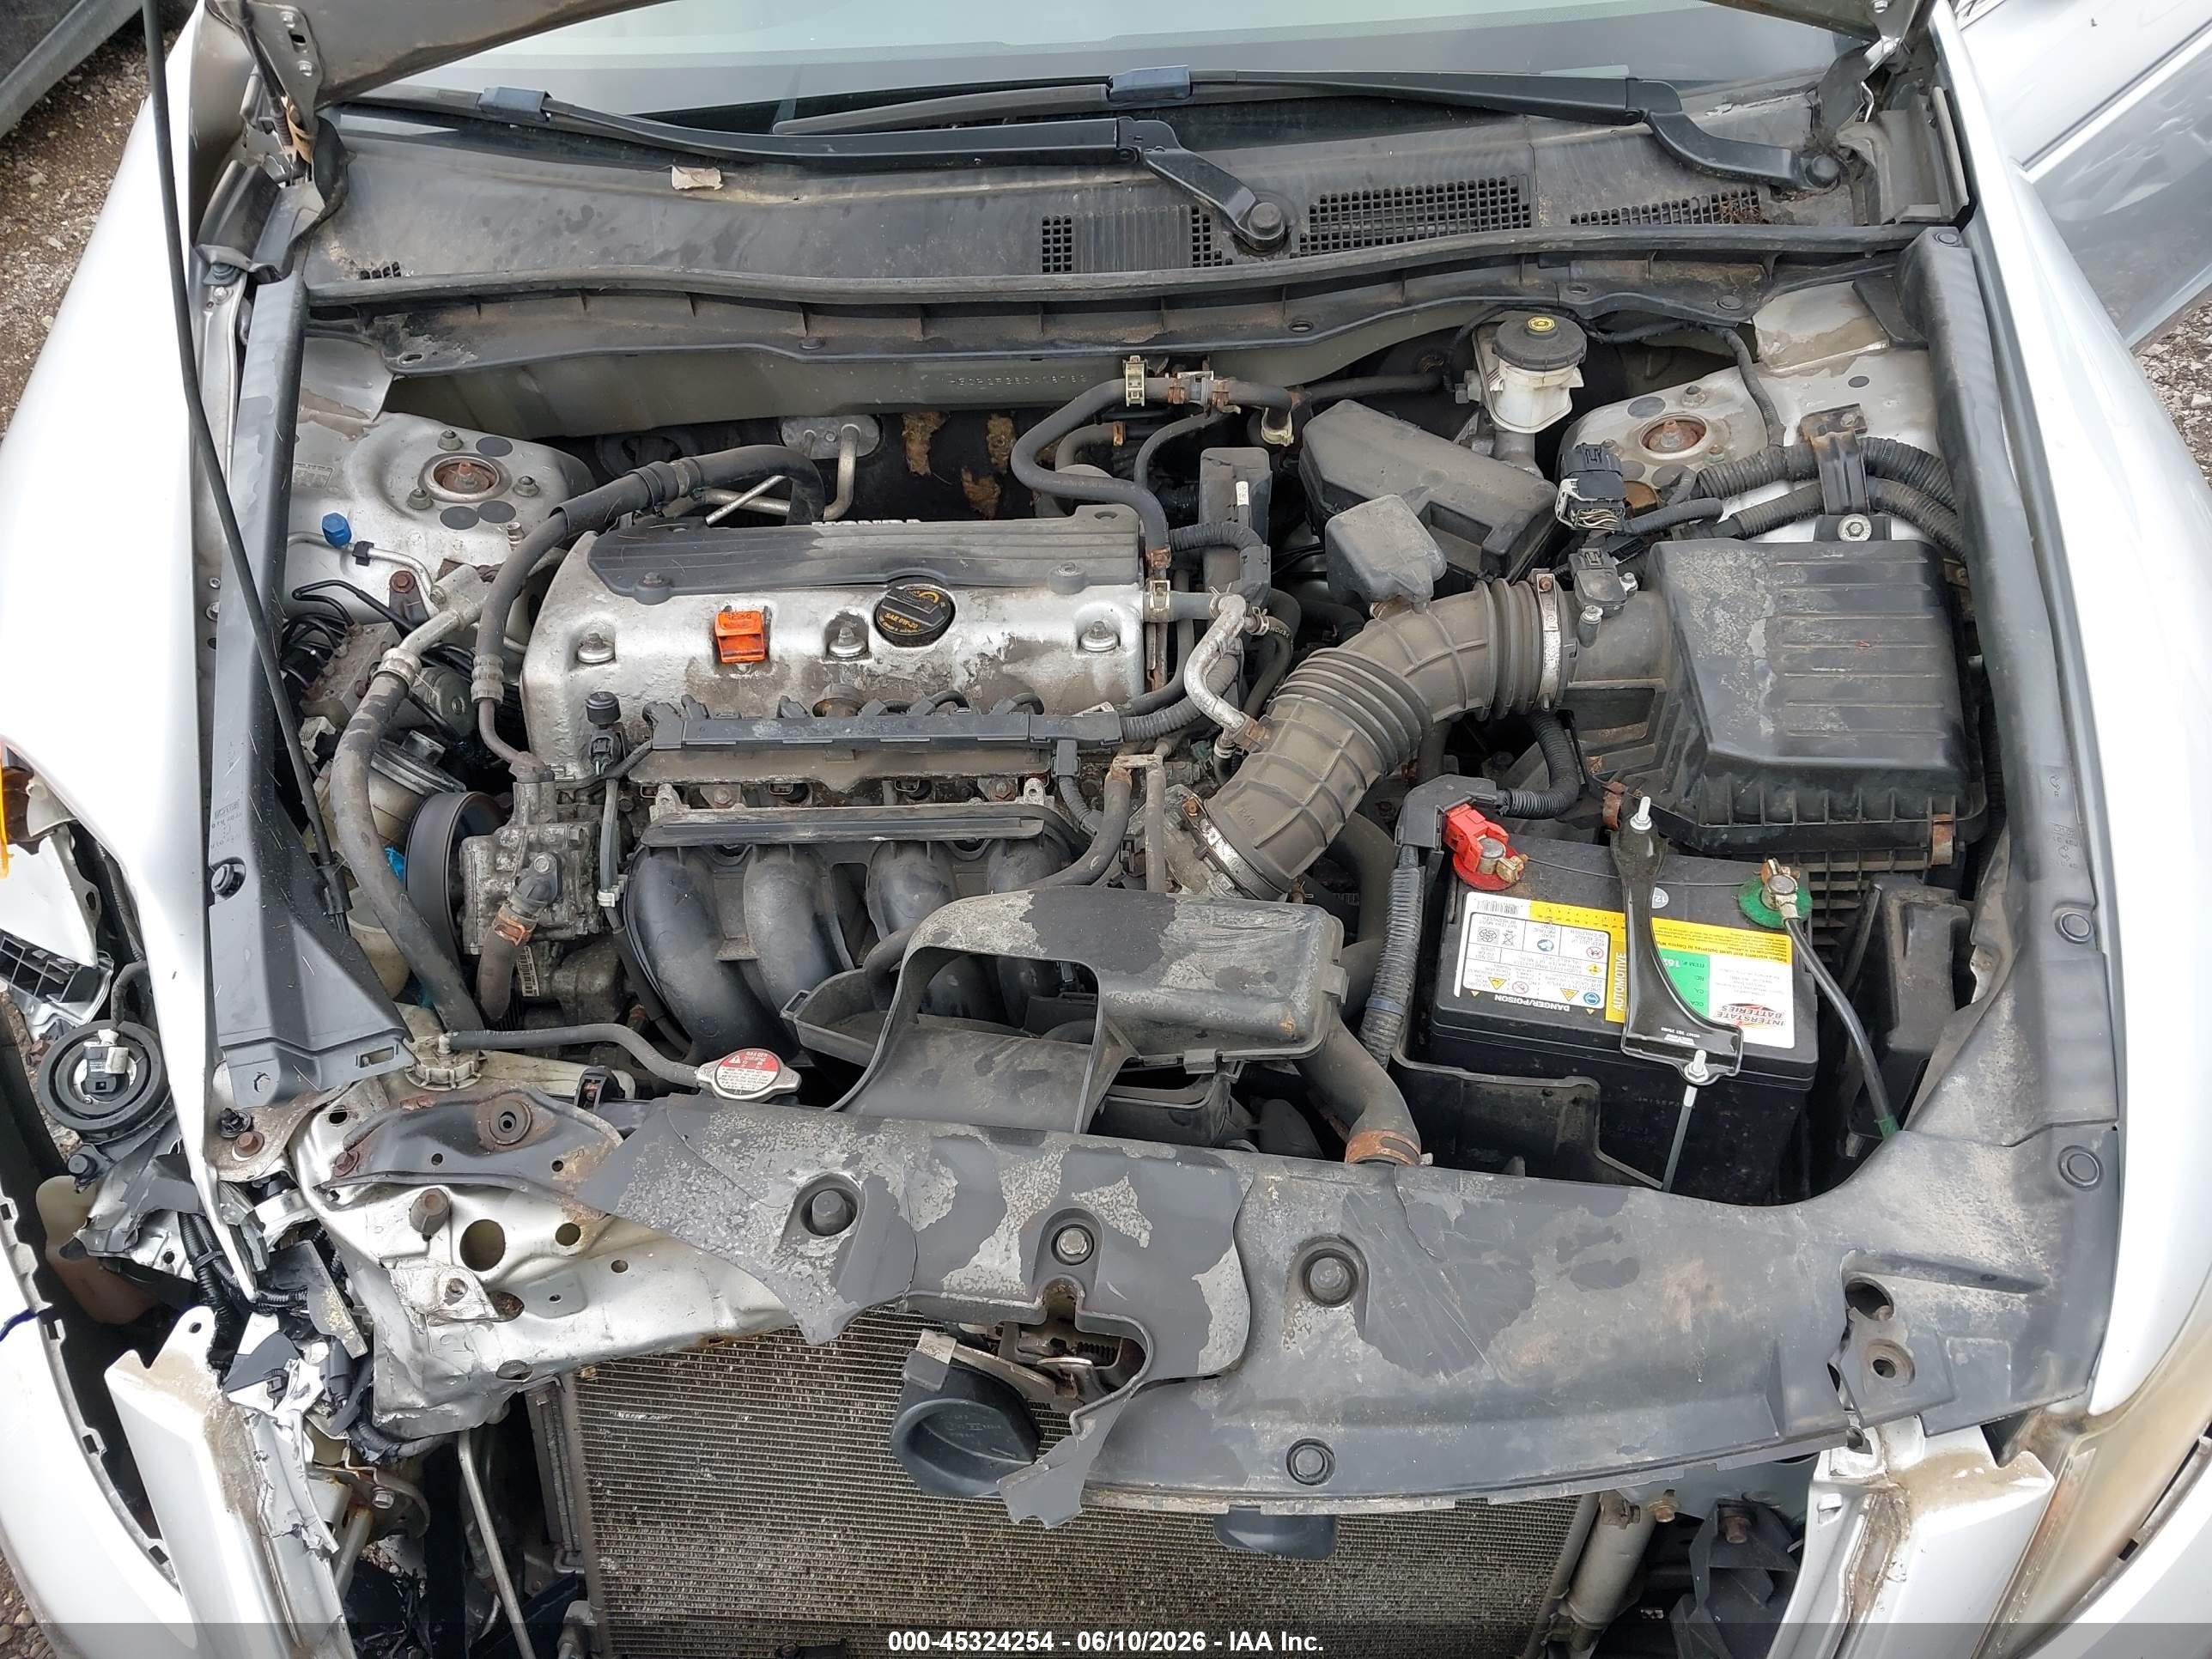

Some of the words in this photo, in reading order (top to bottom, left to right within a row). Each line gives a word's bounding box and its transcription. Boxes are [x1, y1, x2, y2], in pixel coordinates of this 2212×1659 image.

[1612, 951, 1627, 1011] AUTOMOTIVE
[1493, 994, 1570, 1012] DANGER/POISON
[1716, 1011, 1784, 1026] INTERSTATE
[1721, 1005, 1782, 1018] BATTERIES
